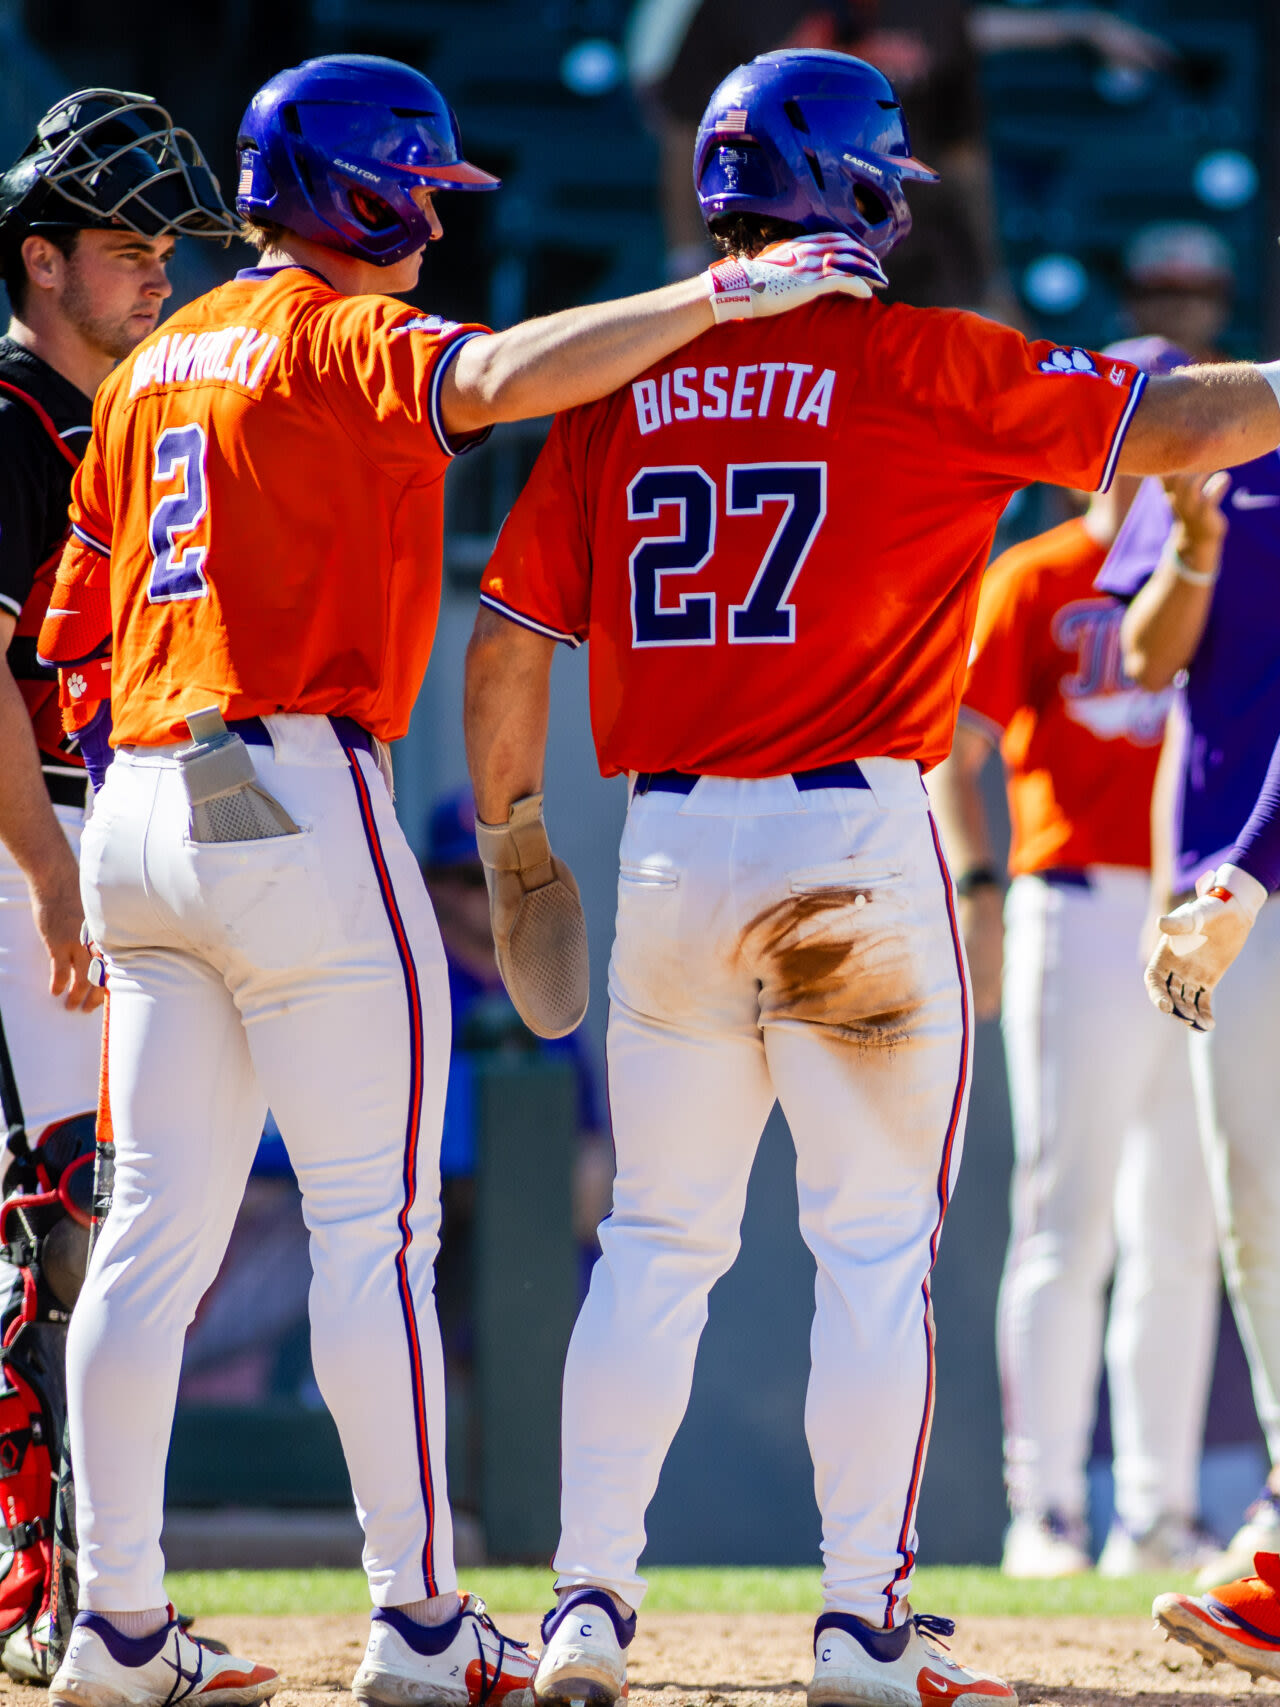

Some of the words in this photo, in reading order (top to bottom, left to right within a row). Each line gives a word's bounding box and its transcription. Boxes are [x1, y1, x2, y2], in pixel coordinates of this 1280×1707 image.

[333, 158, 381, 183] EASTON
[843, 153, 883, 176] EASTON
[632, 362, 836, 435] BISSETTA
[147, 422, 209, 604] 2
[626, 461, 827, 649] 27
[822, 1649, 831, 1662] C
[449, 1666, 459, 1677] 2
